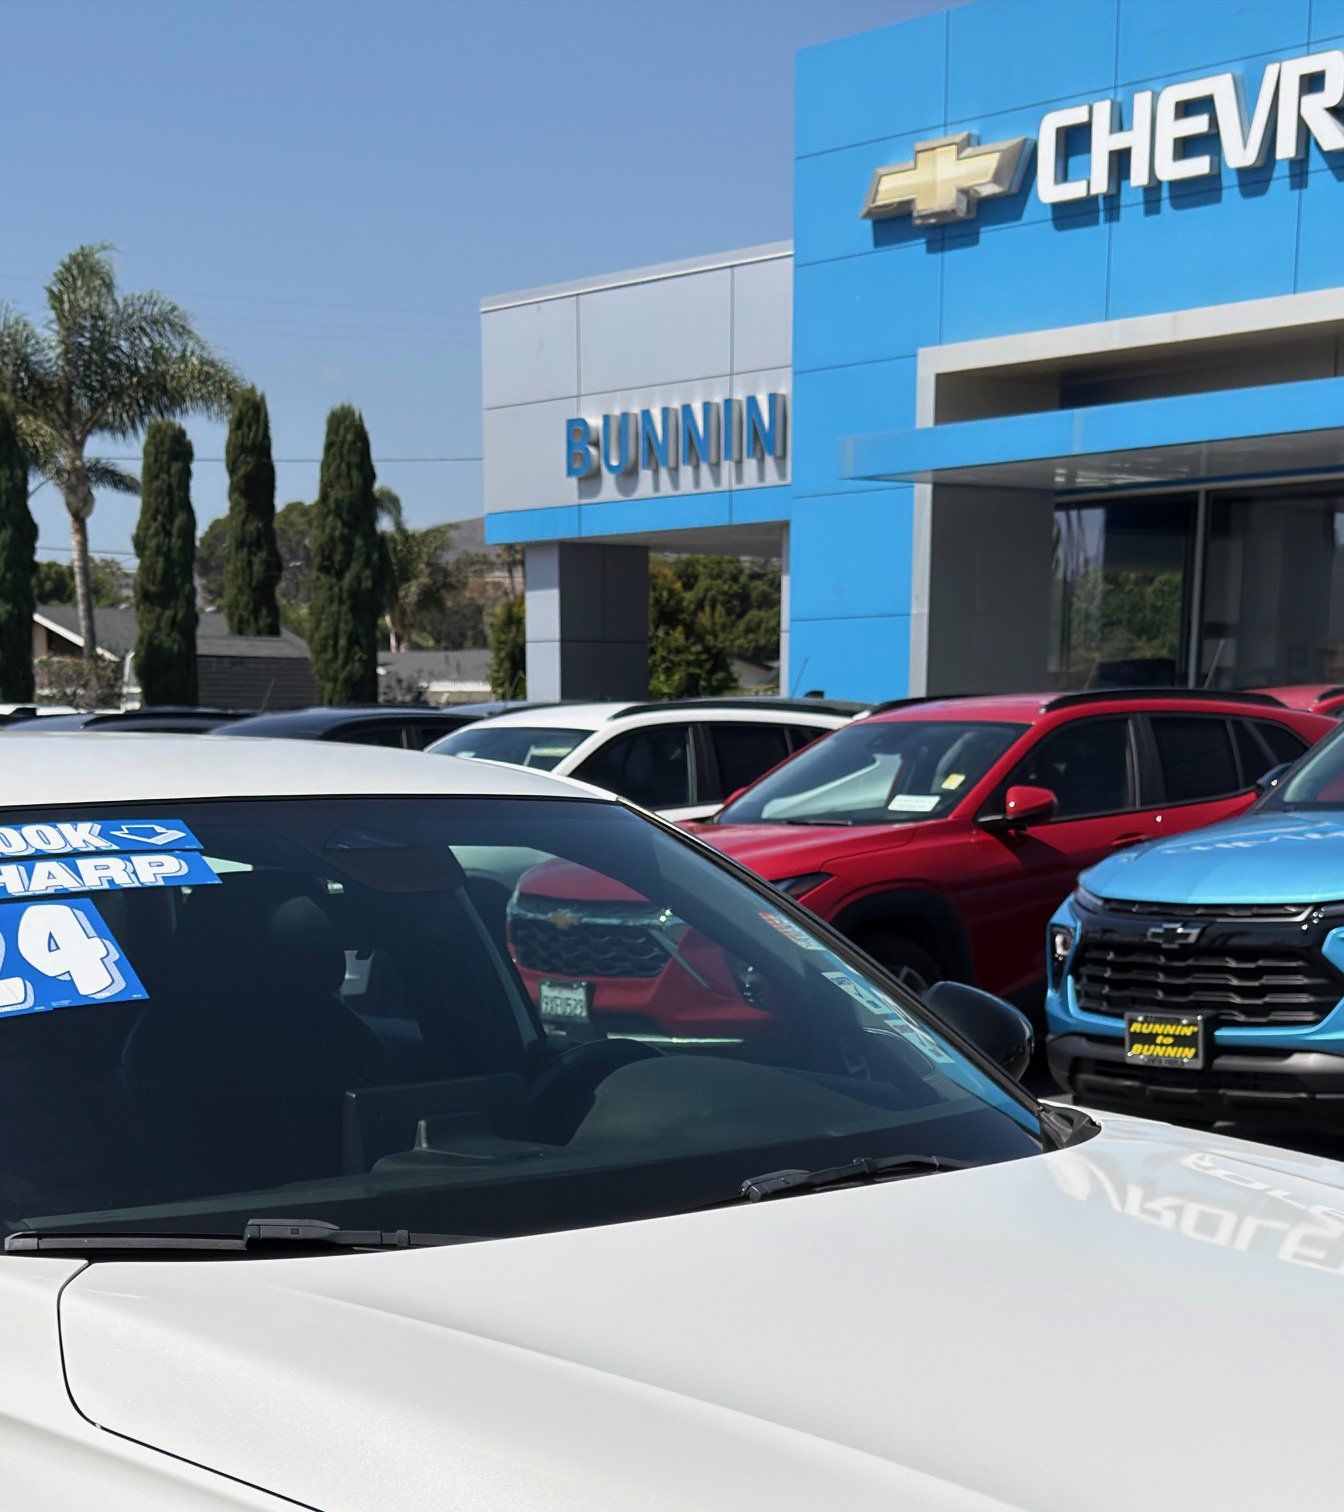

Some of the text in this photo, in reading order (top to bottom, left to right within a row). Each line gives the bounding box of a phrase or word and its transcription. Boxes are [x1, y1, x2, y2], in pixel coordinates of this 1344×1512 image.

[565, 392, 786, 479] BUNNIN
[1155, 1034, 1175, 1045] to
[1131, 1043, 1197, 1059] BUNNIN
